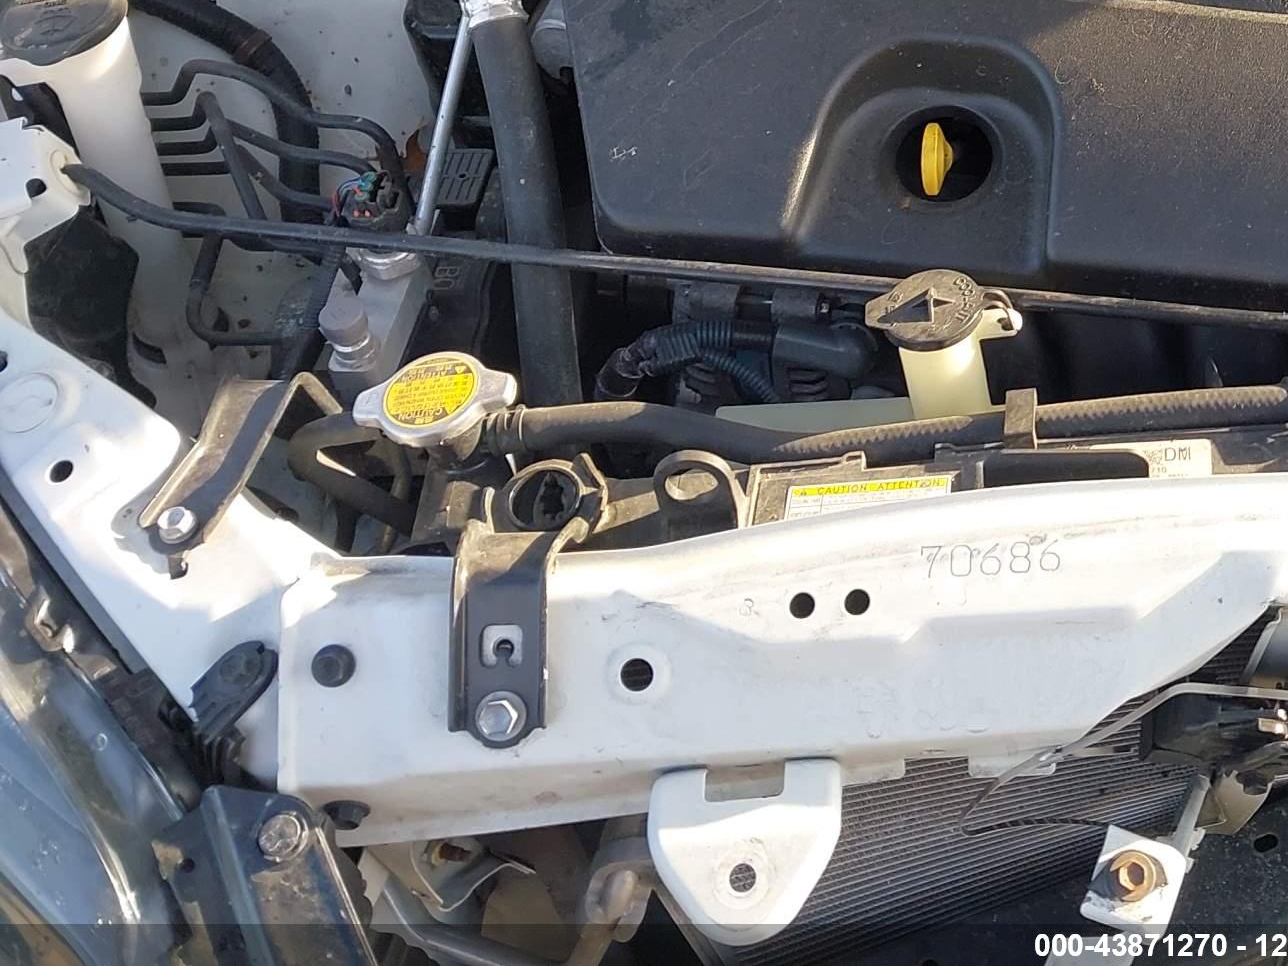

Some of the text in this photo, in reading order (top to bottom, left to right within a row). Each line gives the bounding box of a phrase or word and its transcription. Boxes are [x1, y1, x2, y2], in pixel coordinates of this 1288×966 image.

[398, 406, 444, 420] CAUTION
[818, 484, 868, 495] CAUTION
[921, 538, 1061, 579] 70686
